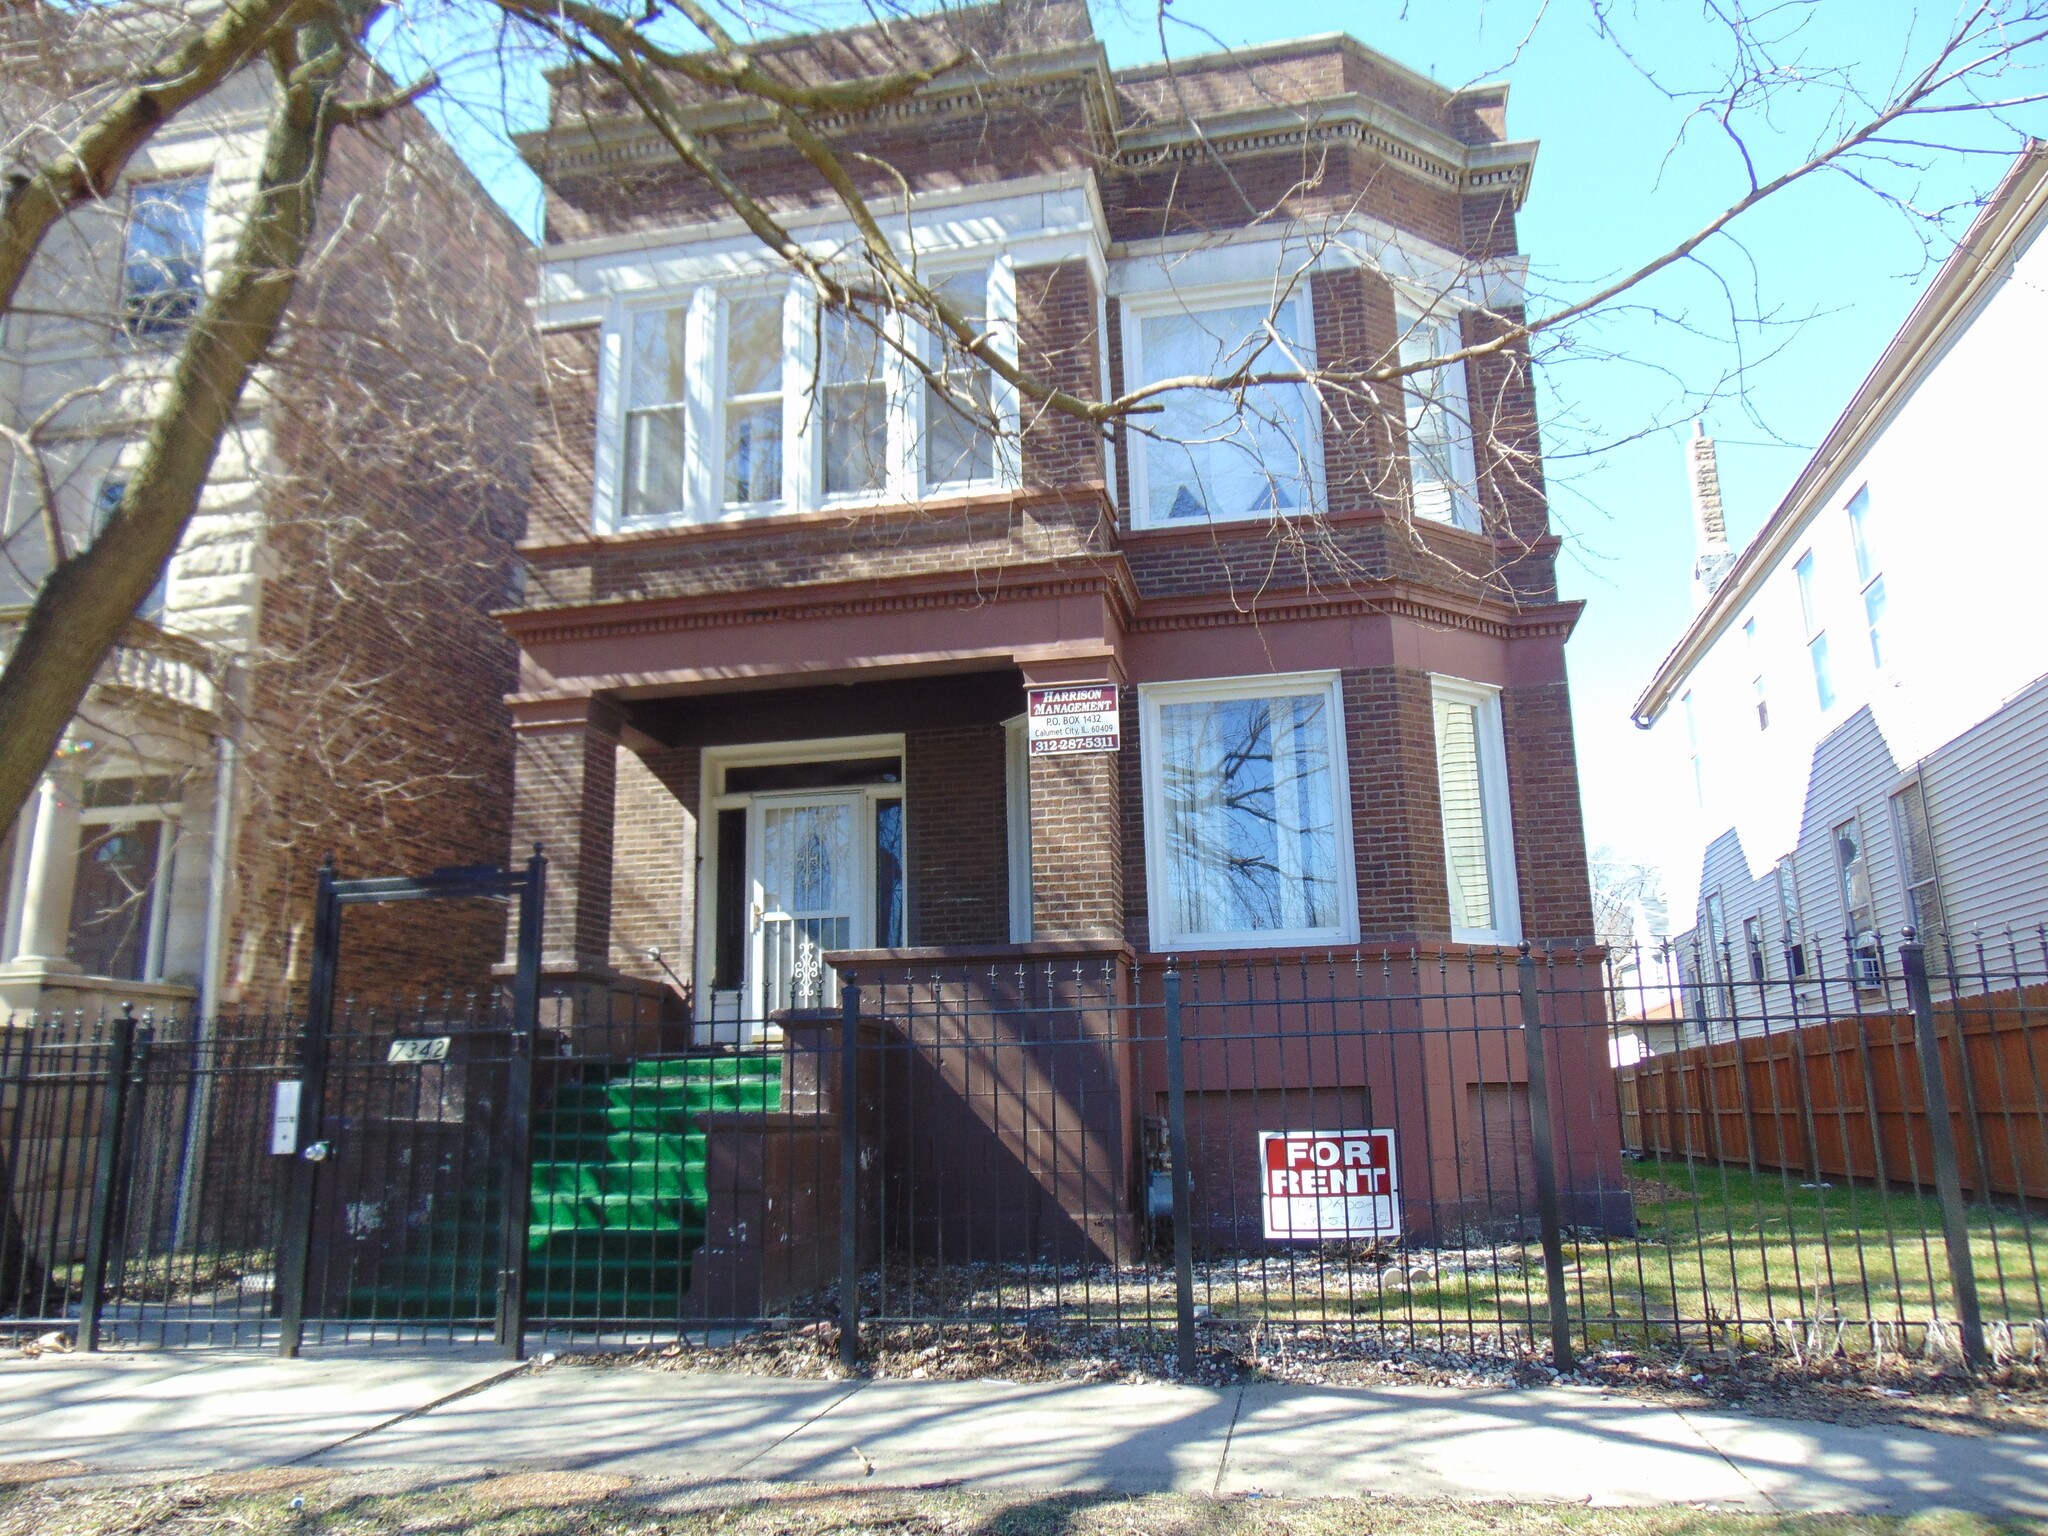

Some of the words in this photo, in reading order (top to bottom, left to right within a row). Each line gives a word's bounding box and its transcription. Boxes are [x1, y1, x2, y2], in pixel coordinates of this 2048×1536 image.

[1043, 689, 1102, 703] HARRISON
[1034, 700, 1112, 715] MANAGEMENT
[1046, 717, 1061, 726] P.O.
[1063, 715, 1080, 725] BOX
[1083, 714, 1102, 723] 1432
[1034, 728, 1063, 737] Calumet
[1064, 727, 1080, 736] City,
[1091, 724, 1113, 733] 60409
[1035, 737, 1114, 751] 312-287-5311
[391, 1040, 446, 1060] 7342
[1286, 1140, 1371, 1167] FOR
[1271, 1167, 1386, 1195] RENT
